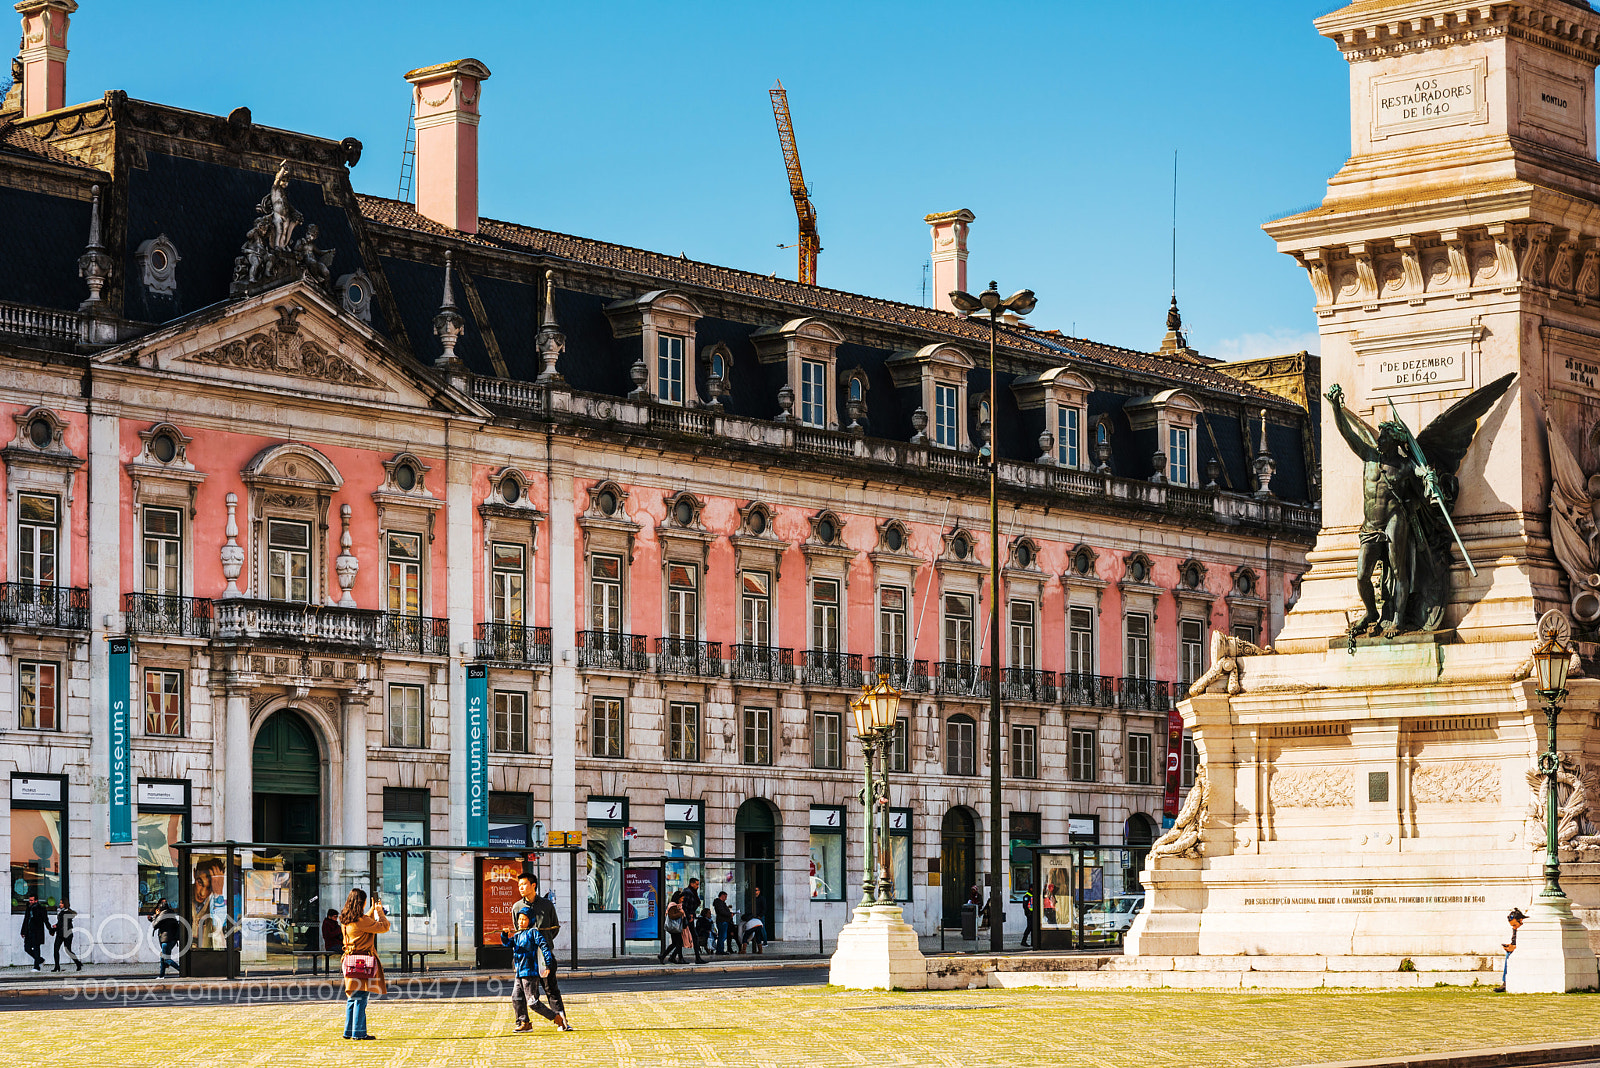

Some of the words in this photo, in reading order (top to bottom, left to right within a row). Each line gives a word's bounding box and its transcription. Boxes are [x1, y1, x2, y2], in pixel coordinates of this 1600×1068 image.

[1414, 79, 1438, 92] AOS
[1381, 84, 1472, 109] RESTAURADORES
[1541, 92, 1568, 109] MONTIJO
[1403, 107, 1418, 119] DE
[1422, 102, 1450, 116] 1640
[1402, 356, 1454, 371] DEZEMBRO
[1574, 361, 1583, 372] DE
[1583, 364, 1599, 375] MAIO
[1396, 373, 1409, 384] DE
[1411, 369, 1437, 385] 1640
[1570, 371, 1578, 382] DE
[113, 644, 126, 653] Shop
[470, 669, 484, 678] Shop
[113, 700, 124, 806] museums
[468, 696, 481, 817] monuments
[1291, 897, 1317, 905] NACIONAL
